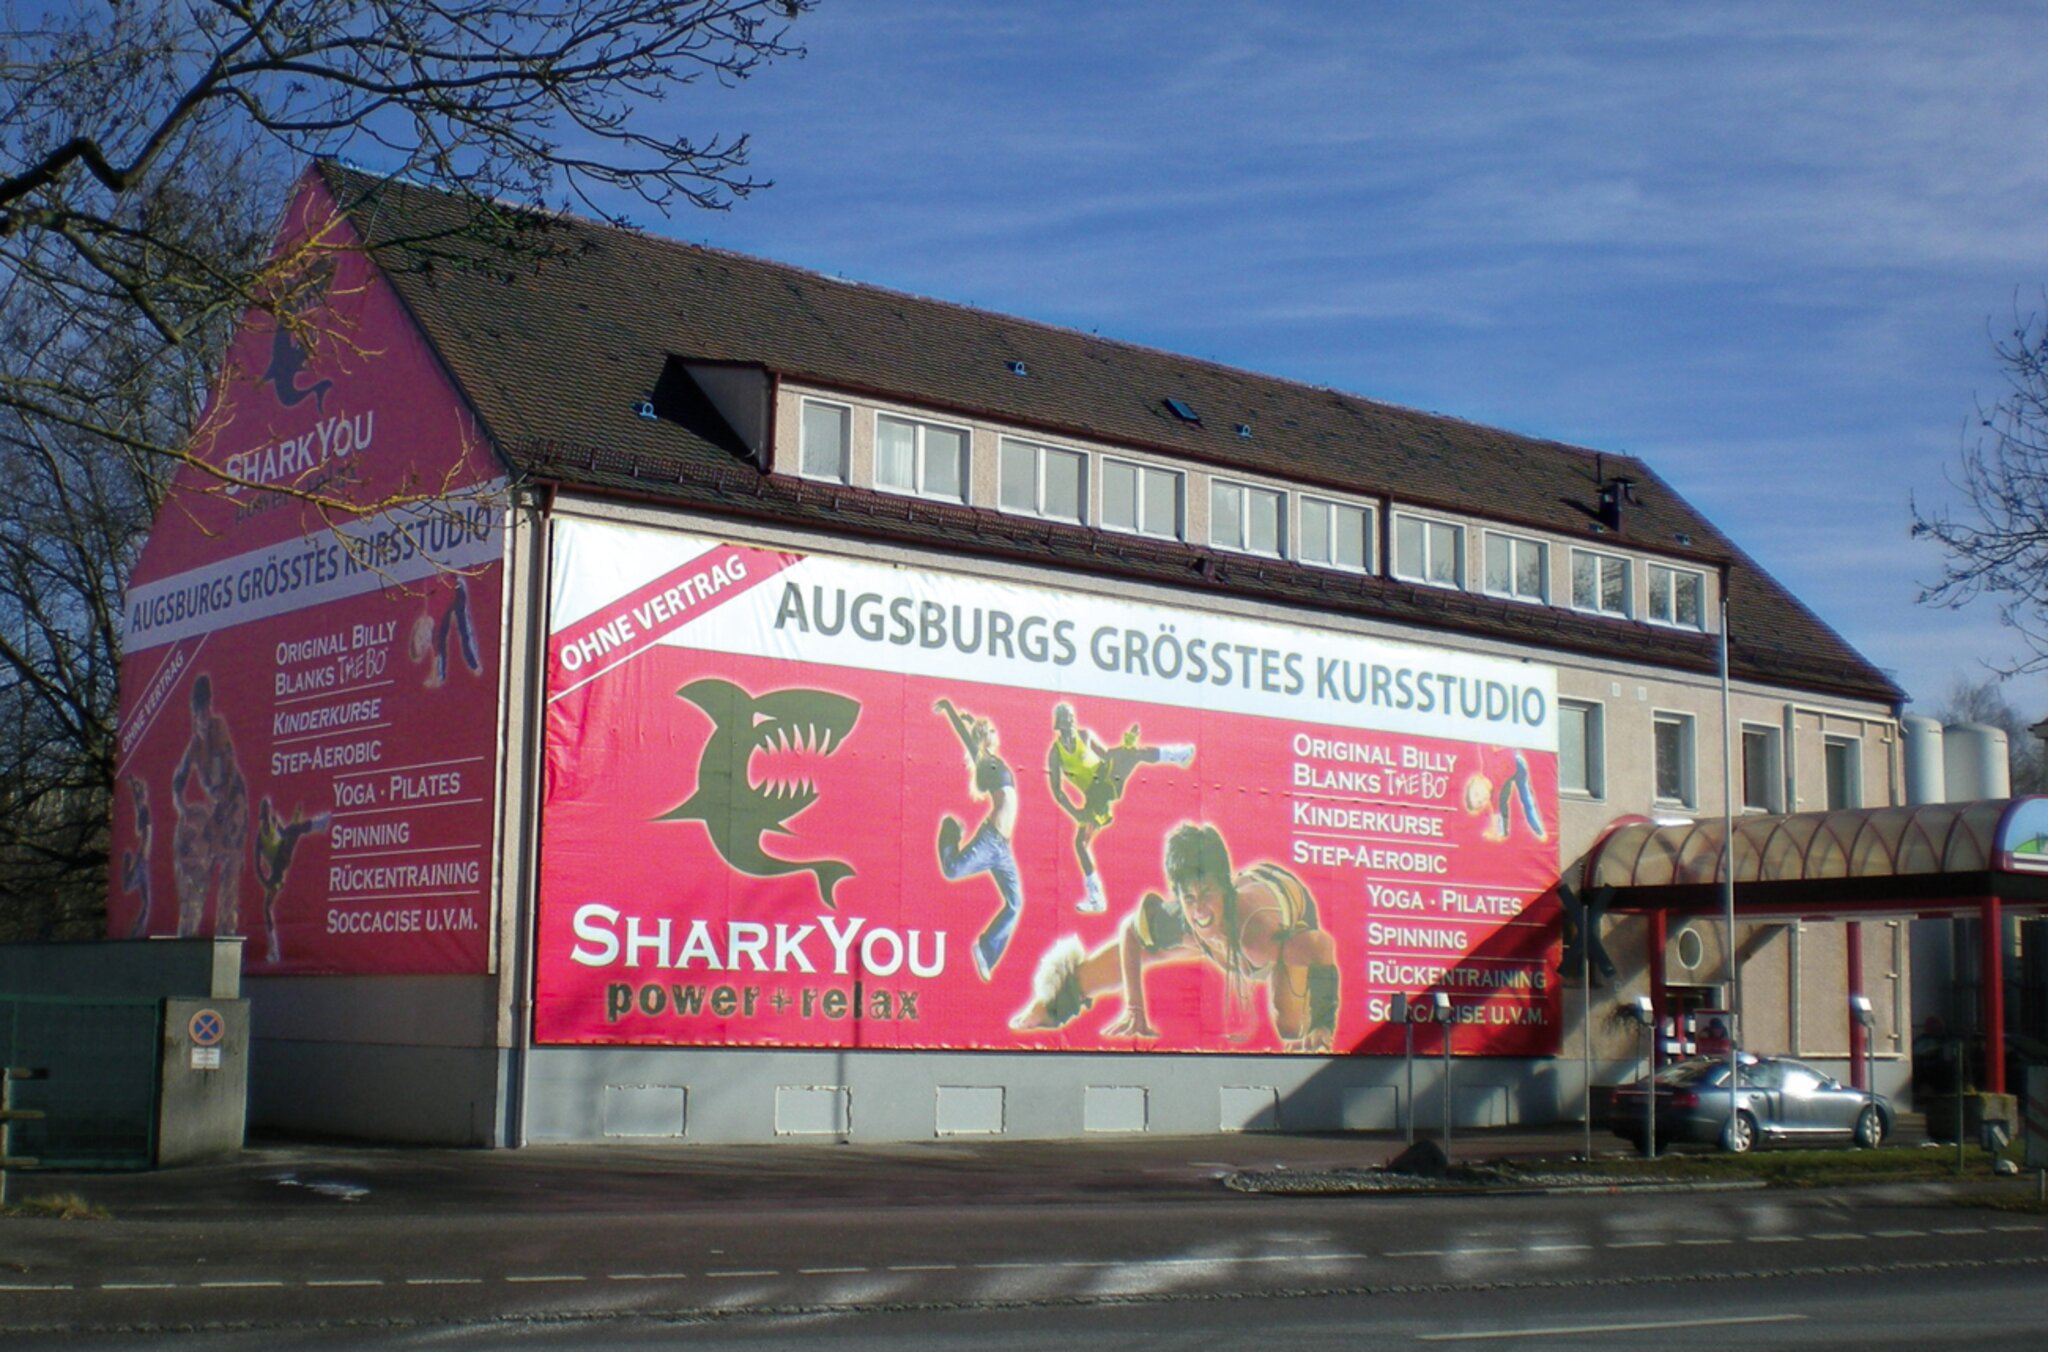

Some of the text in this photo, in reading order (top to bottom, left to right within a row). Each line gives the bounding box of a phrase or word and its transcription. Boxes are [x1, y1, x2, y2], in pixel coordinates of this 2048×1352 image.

[131, 505, 492, 634] AUGSBURGS GRÖSSTES KURSSTUDIO
[559, 554, 749, 673] OHNE VERTRAG
[276, 620, 397, 666] ORIGINAL BILLY
[774, 580, 1546, 728] AUGSBURGS GRÖSSTES KURSSTUDIO
[144, 649, 184, 716] VERTRAG
[275, 665, 336, 697] BLANKS
[273, 698, 382, 736] KINDERKURSE
[271, 740, 382, 776] STEP-AEROBIC
[1292, 732, 1457, 773] ORIGINAL BILLY
[332, 771, 461, 808] YOGA PILATES
[1293, 763, 1381, 793] BLANKS
[331, 821, 410, 850] SPINNING
[1292, 801, 1444, 837] KINDERKURSE
[1292, 840, 1448, 874] STEP-AEROBIC
[328, 861, 480, 892] RÜCKENTRAINING
[1366, 883, 1523, 915] YOGA PILATES
[326, 908, 422, 934] SOCCACISE
[1367, 922, 1468, 950] SPINNING
[1367, 959, 1547, 989] RÜCKENTRAINING
